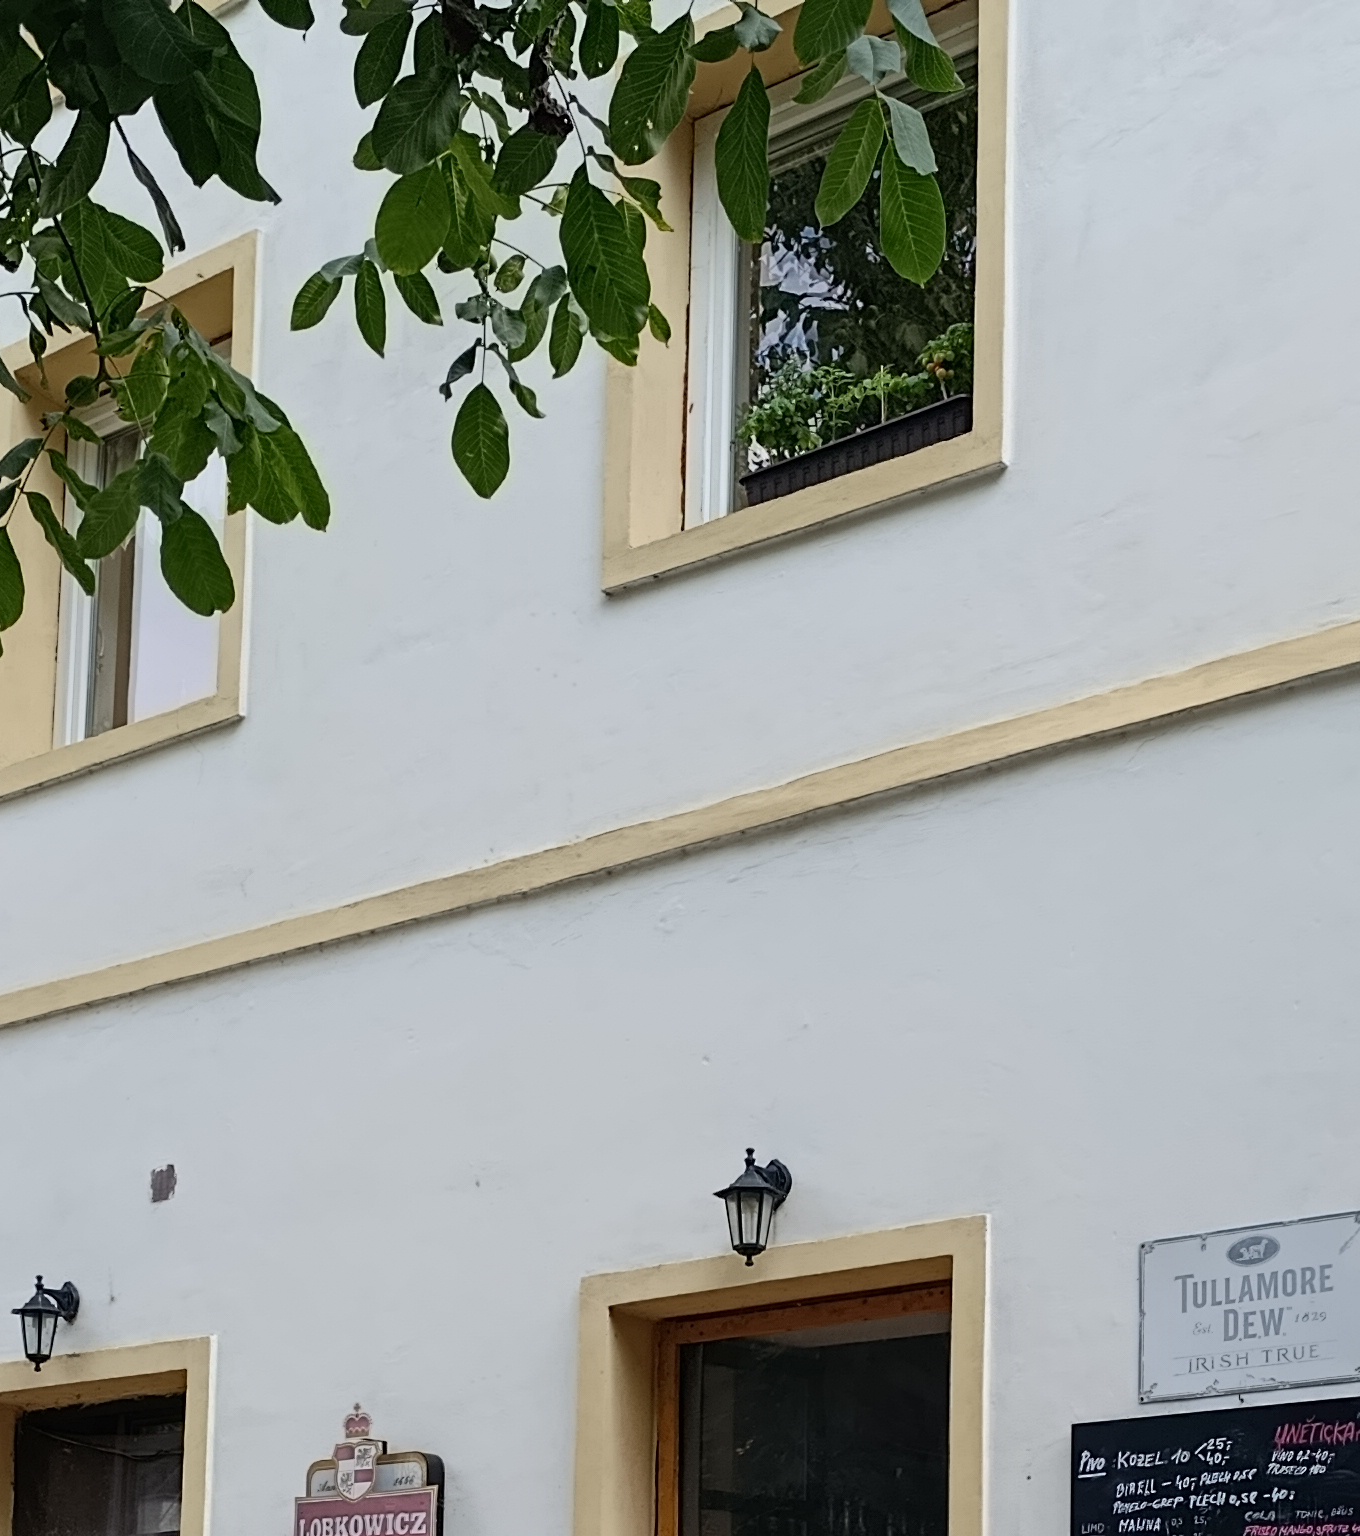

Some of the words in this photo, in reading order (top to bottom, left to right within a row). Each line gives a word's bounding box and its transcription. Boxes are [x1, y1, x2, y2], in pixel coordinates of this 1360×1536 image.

[1174, 1264, 1334, 1314] TULLAMORE
[1223, 1307, 1287, 1342] D.E.W.
[1295, 1311, 1327, 1323] 1829
[1188, 1352, 1249, 1374] IRISH
[1262, 1344, 1320, 1364] TRUE
[1171, 1449, 1191, 1465] 10
[1189, 1491, 1227, 1509] PLECH
[1243, 1510, 1276, 1522] COLA
[1117, 1517, 1162, 1534] MALINA
